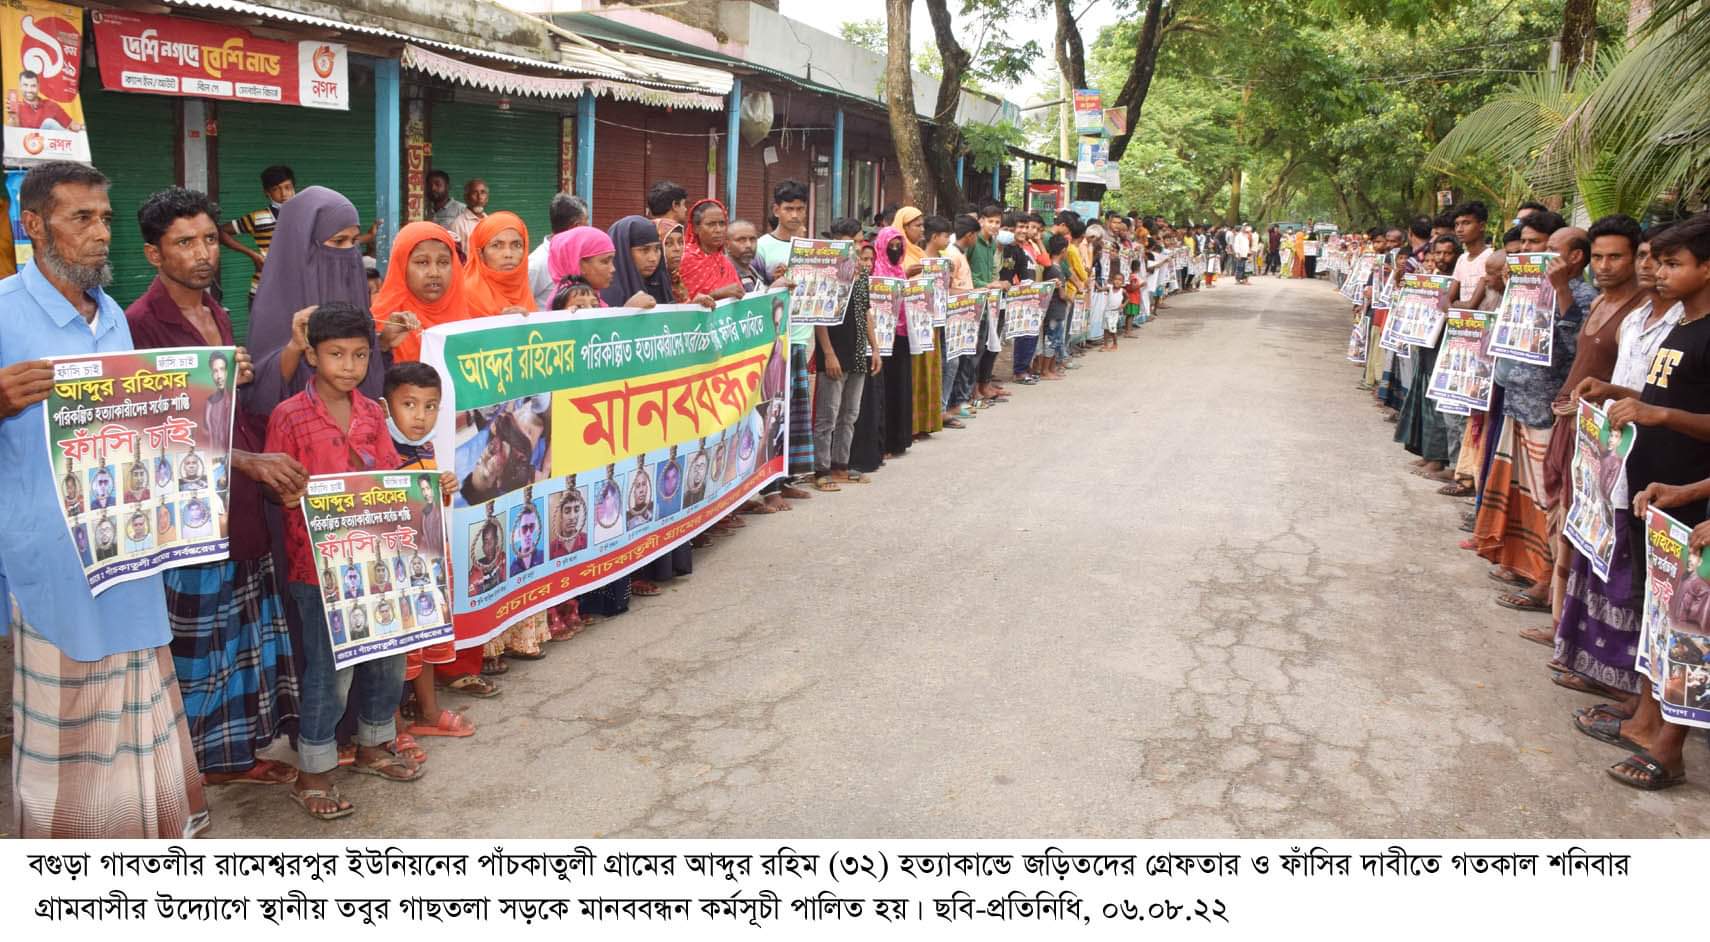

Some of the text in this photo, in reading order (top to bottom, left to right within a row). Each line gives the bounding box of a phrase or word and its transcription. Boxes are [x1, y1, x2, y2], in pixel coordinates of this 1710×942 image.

[121, 28, 281, 79] দেশি নগদে বেশি লাভ
[312, 79, 338, 99] নগদ
[48, 137, 73, 152] নগদ
[457, 347, 513, 395] আব্দুর
[518, 330, 577, 380] রহিমের
[580, 331, 633, 369] পরিকল্পিত
[55, 369, 189, 402] আব্দুর রহিমের
[53, 404, 94, 427] পরিকল্পিত
[95, 399, 148, 422] হত্যাকারীদের
[568, 354, 768, 456] মানববন্ধন
[58, 415, 198, 462] ফাঁসি চাই
[308, 486, 408, 512] আব্দুর রহিমের
[315, 525, 418, 560] ফাঁসি চাই
[496, 581, 553, 619] প্রচারে
[579, 534, 660, 579] পাঁচকাতুলী
